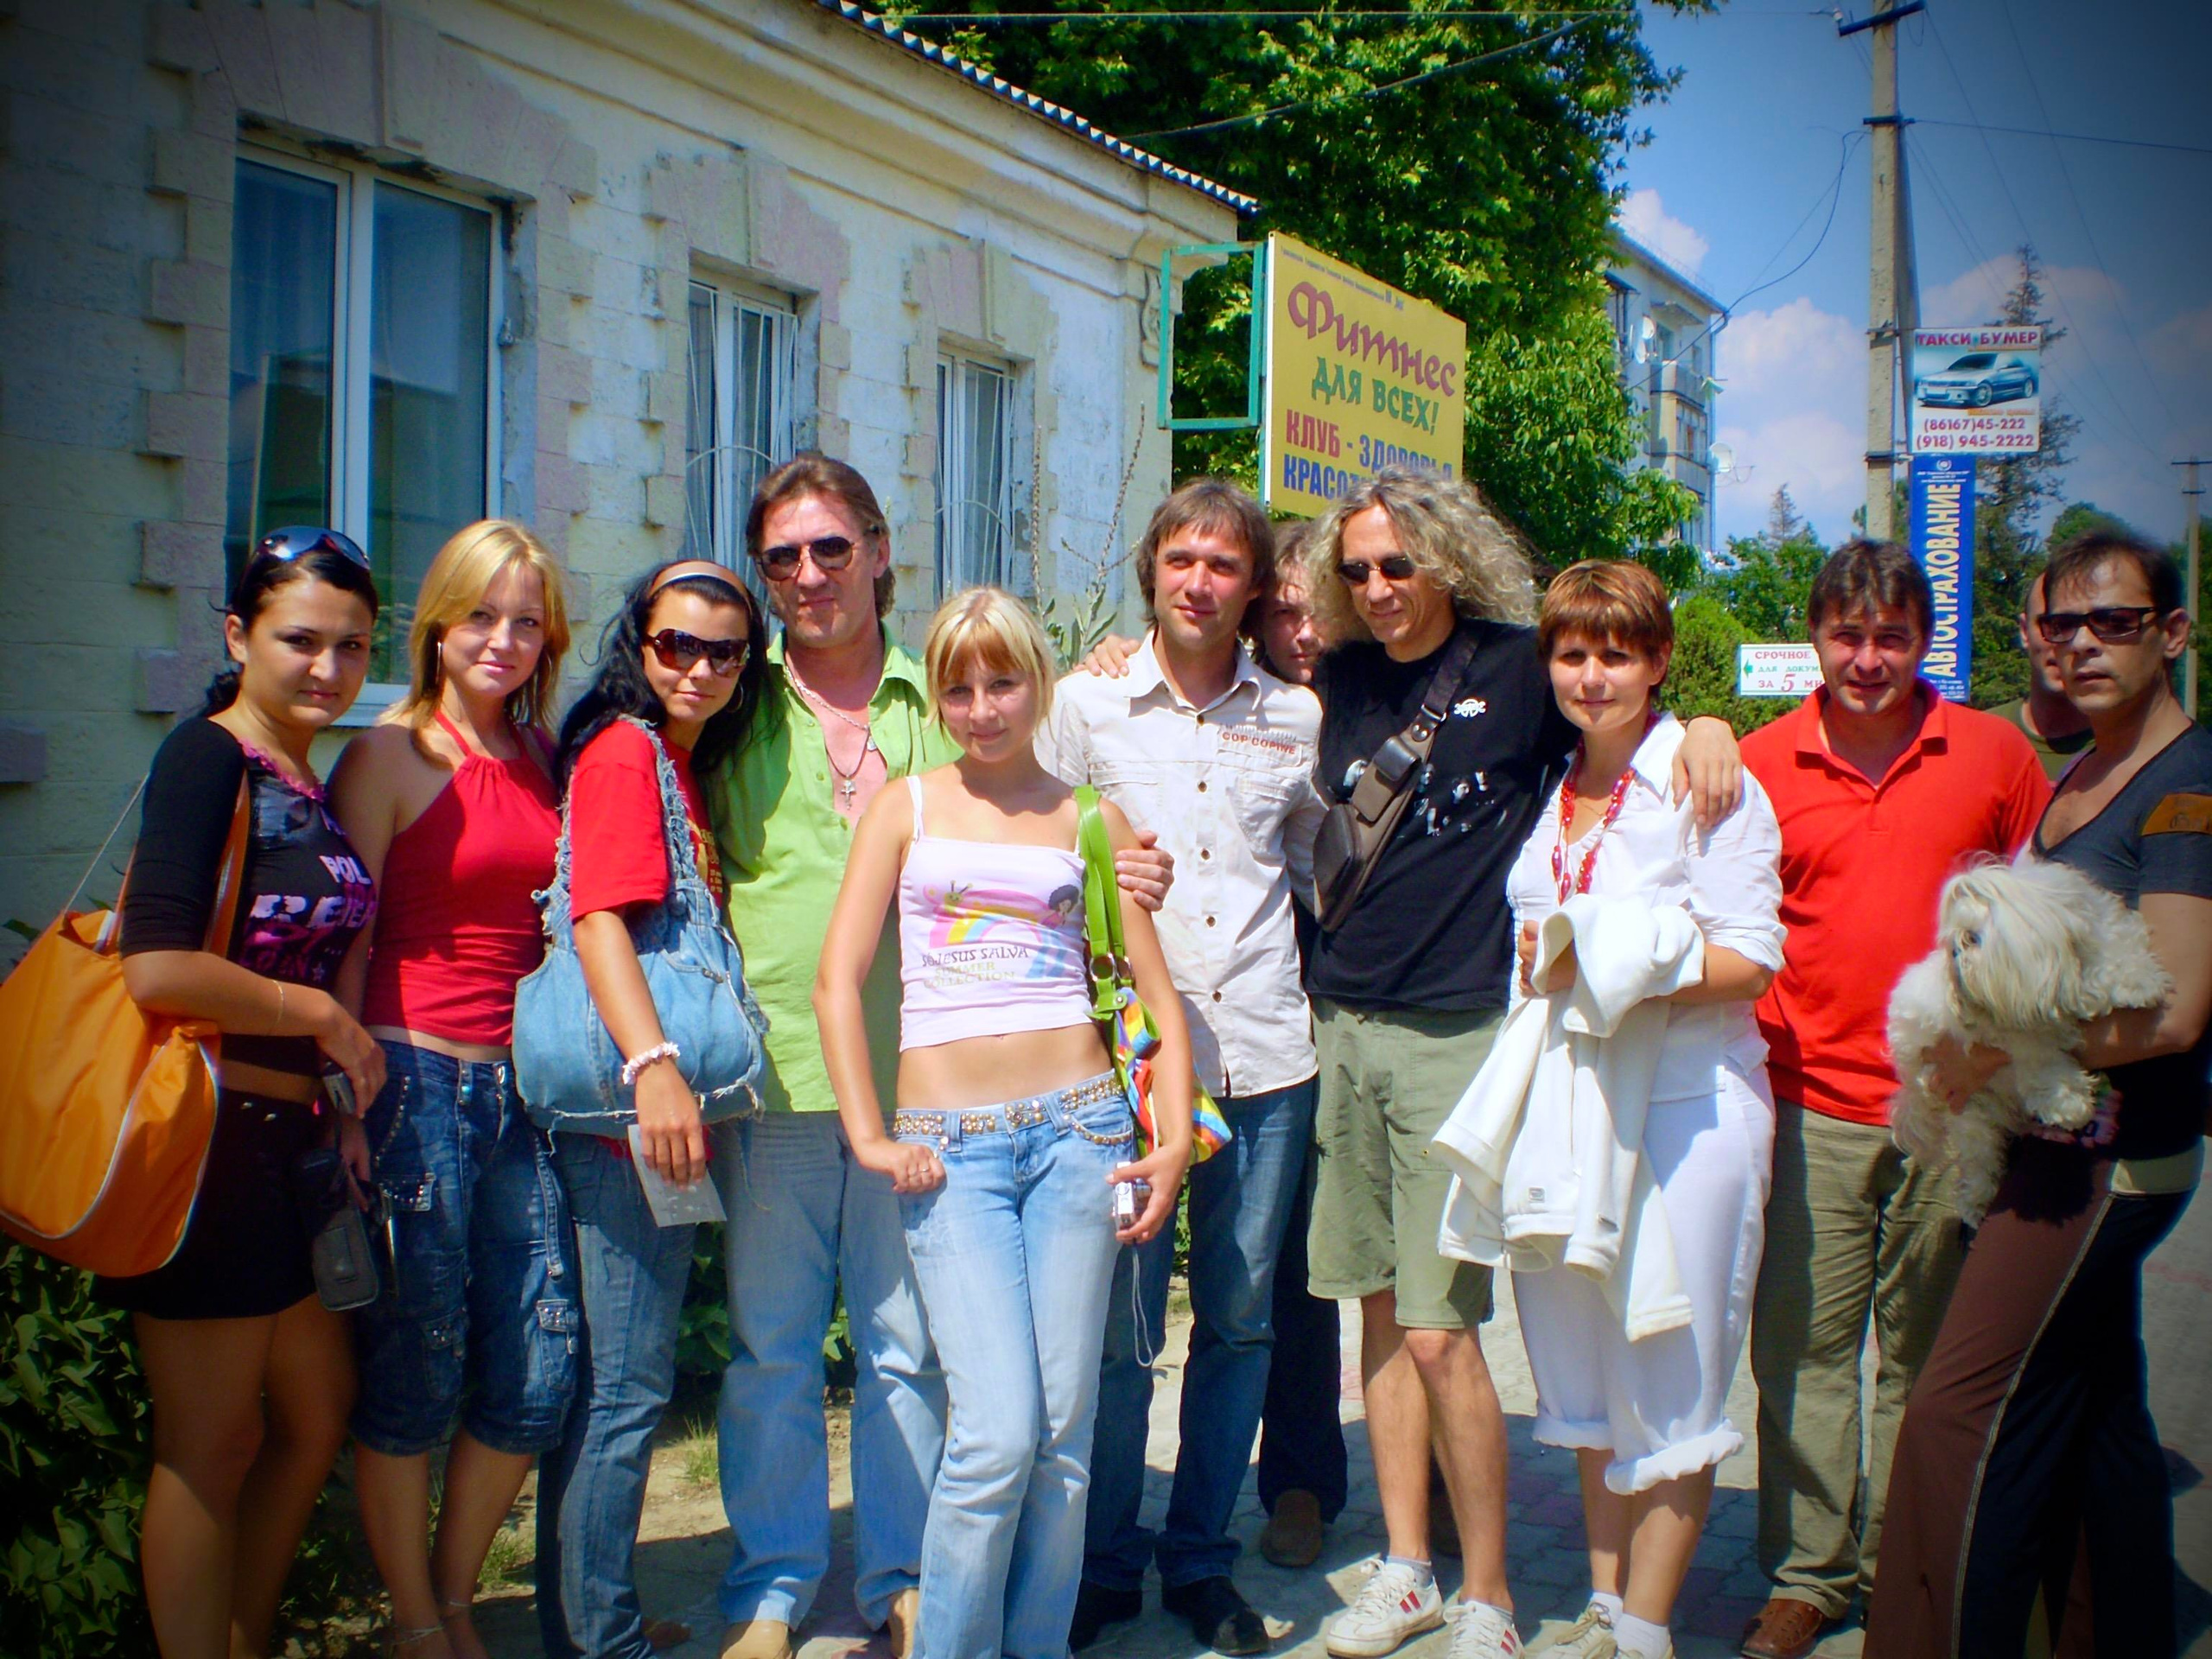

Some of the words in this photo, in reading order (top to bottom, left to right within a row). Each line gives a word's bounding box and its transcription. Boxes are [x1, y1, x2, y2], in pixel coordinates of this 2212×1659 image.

[1287, 282, 1457, 397] Фитнес
[1916, 333, 1971, 346] ТАКСИ
[1980, 332, 2037, 345] БУМЕР
[1311, 356, 1362, 405] ДЛЯ
[1371, 378, 1440, 436] ВСЕХ!
[1923, 417, 2025, 432] (86167)45-222
[1285, 409, 1341, 458] КЛУБ
[1916, 434, 1955, 450] (918)
[1958, 434, 2035, 448] 945-2222
[1755, 651, 1811, 659] СРОЧНОЕ
[1758, 680, 1774, 689] ЗА
[1781, 673, 1796, 692] 5
[1222, 731, 1249, 743] COP
[981, 945, 1029, 960] SALVA
